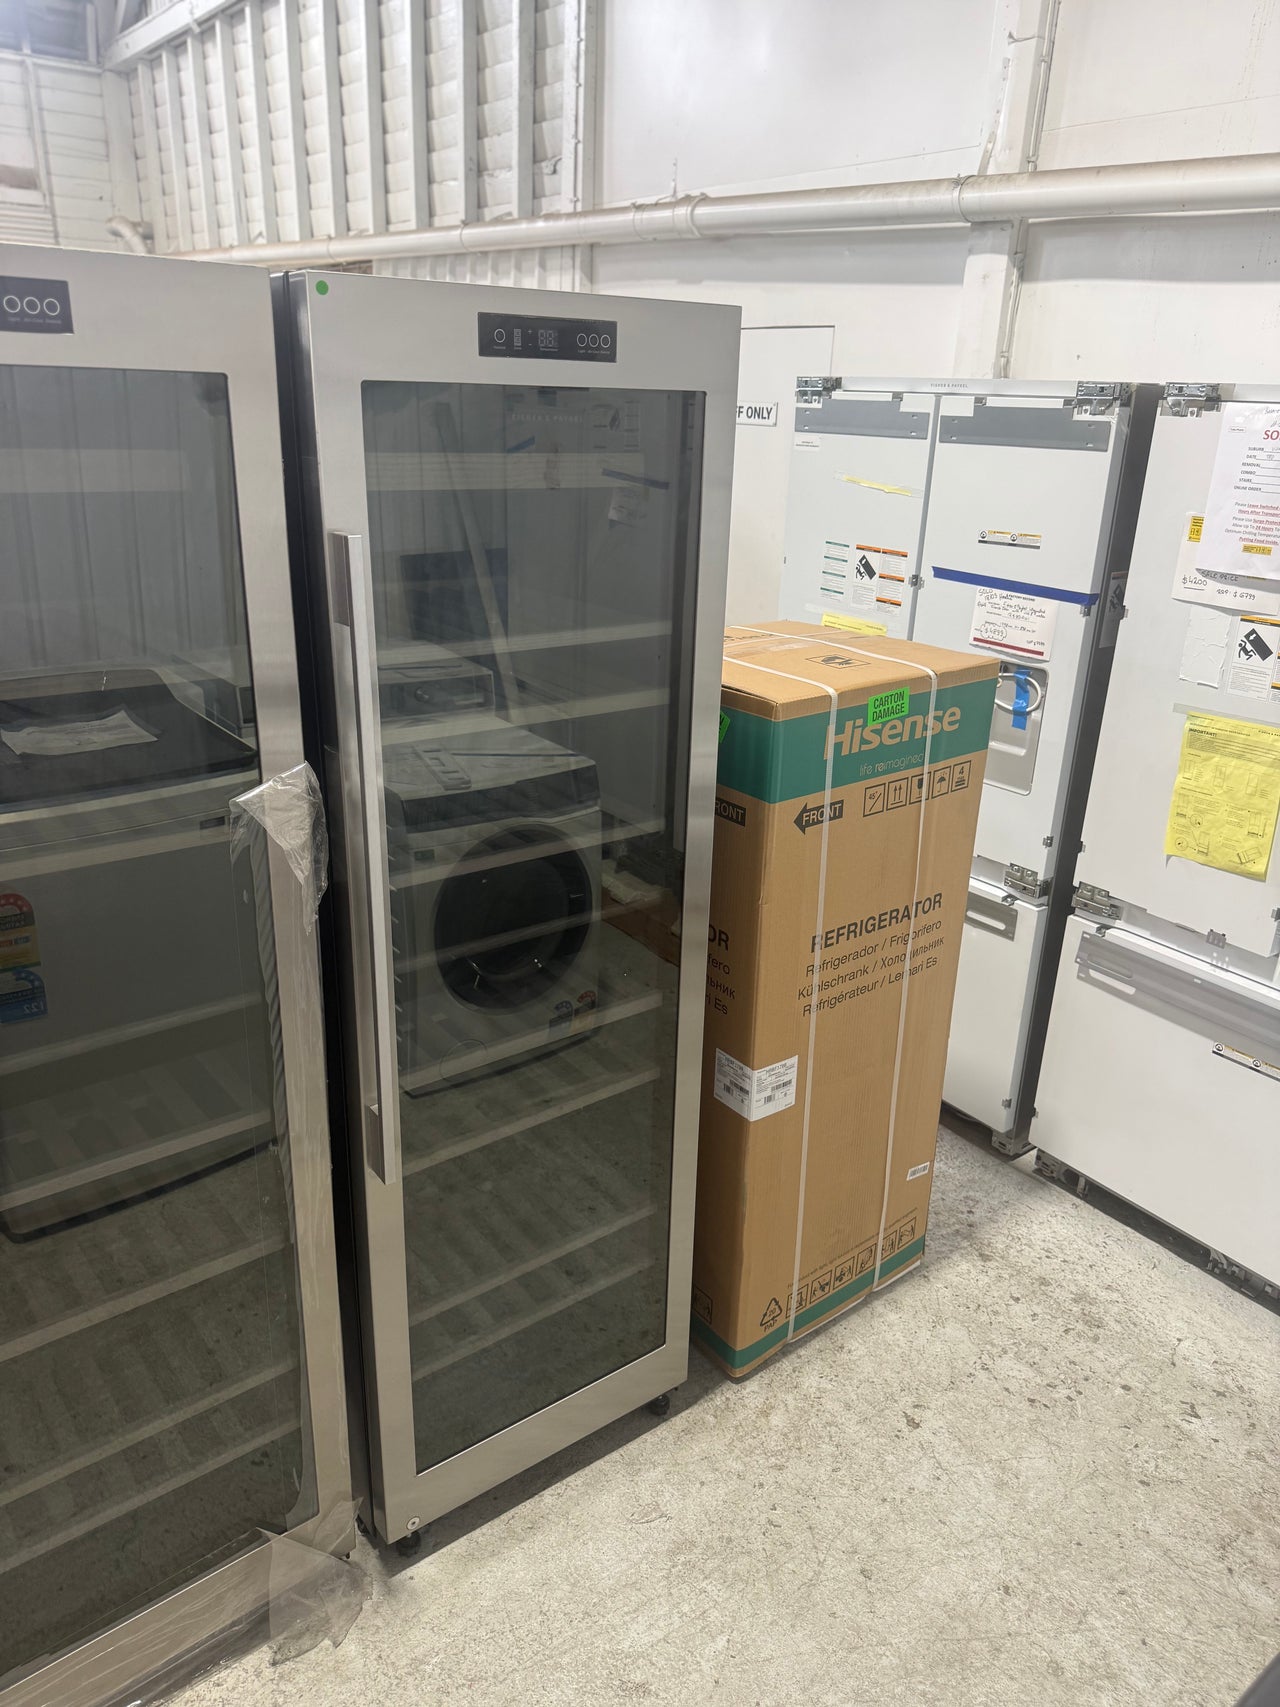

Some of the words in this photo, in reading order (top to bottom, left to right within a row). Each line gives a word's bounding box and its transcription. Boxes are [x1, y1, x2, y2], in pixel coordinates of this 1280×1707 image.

[746, 406, 773, 421] ONLY
[1263, 429, 1280, 440] SO
[1182, 575, 1208, 587] $4200
[873, 690, 905, 709] CARTON
[872, 702, 905, 722] DAMAGE
[823, 706, 961, 760] Hisense
[1188, 728, 1218, 738] IMPORTANT!
[859, 763, 873, 777] life
[958, 766, 965, 775] 4
[802, 803, 842, 825] FRONT
[811, 892, 943, 953] REFRIGERATOR
[805, 942, 879, 978] Refrigerador
[889, 920, 942, 948] Frigorifero
[880, 936, 945, 971] Холоильник
[802, 979, 879, 1018] Refrigérateur
[926, 955, 938, 969] Es
[714, 996, 728, 1015] Es
[764, 1318, 778, 1333] PAP
